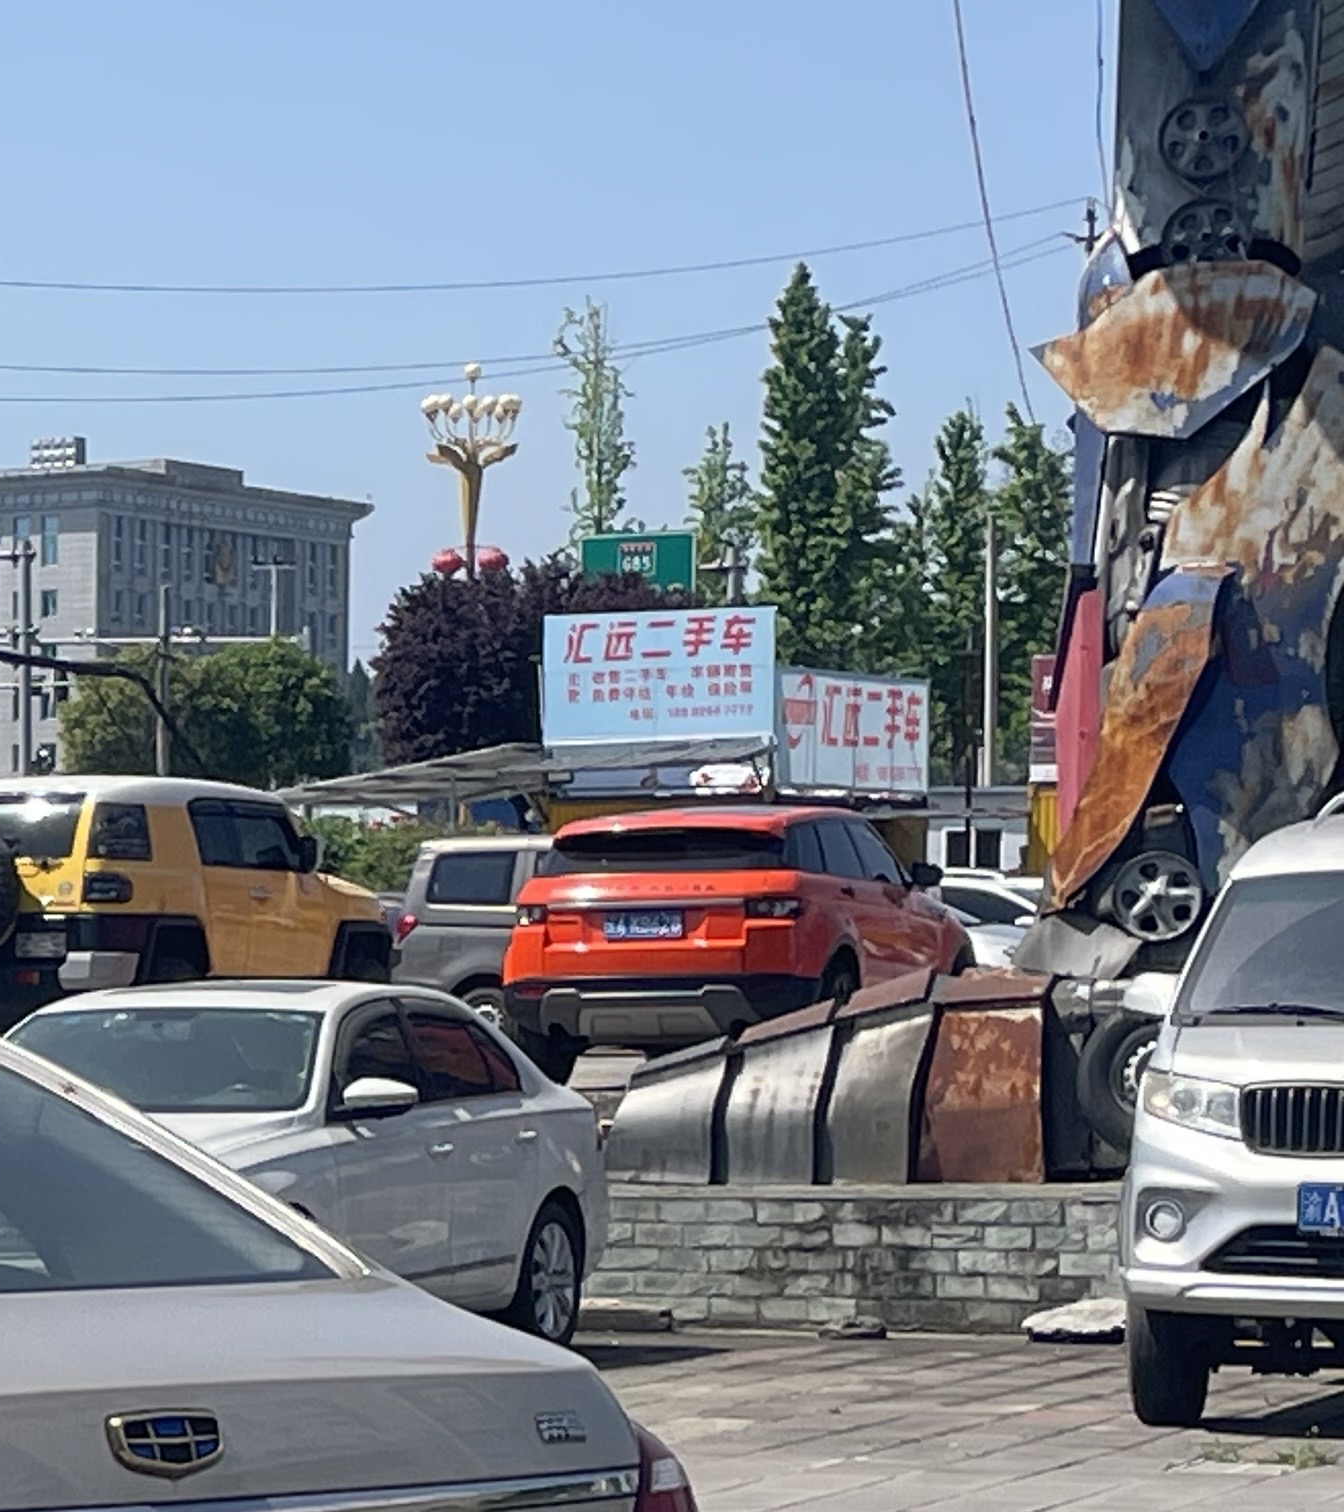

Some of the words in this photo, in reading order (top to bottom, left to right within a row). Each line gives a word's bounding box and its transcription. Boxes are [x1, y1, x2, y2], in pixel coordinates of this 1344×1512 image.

[563, 614, 757, 664] 汇远二手车
[821, 684, 923, 751] 汇远二手车
